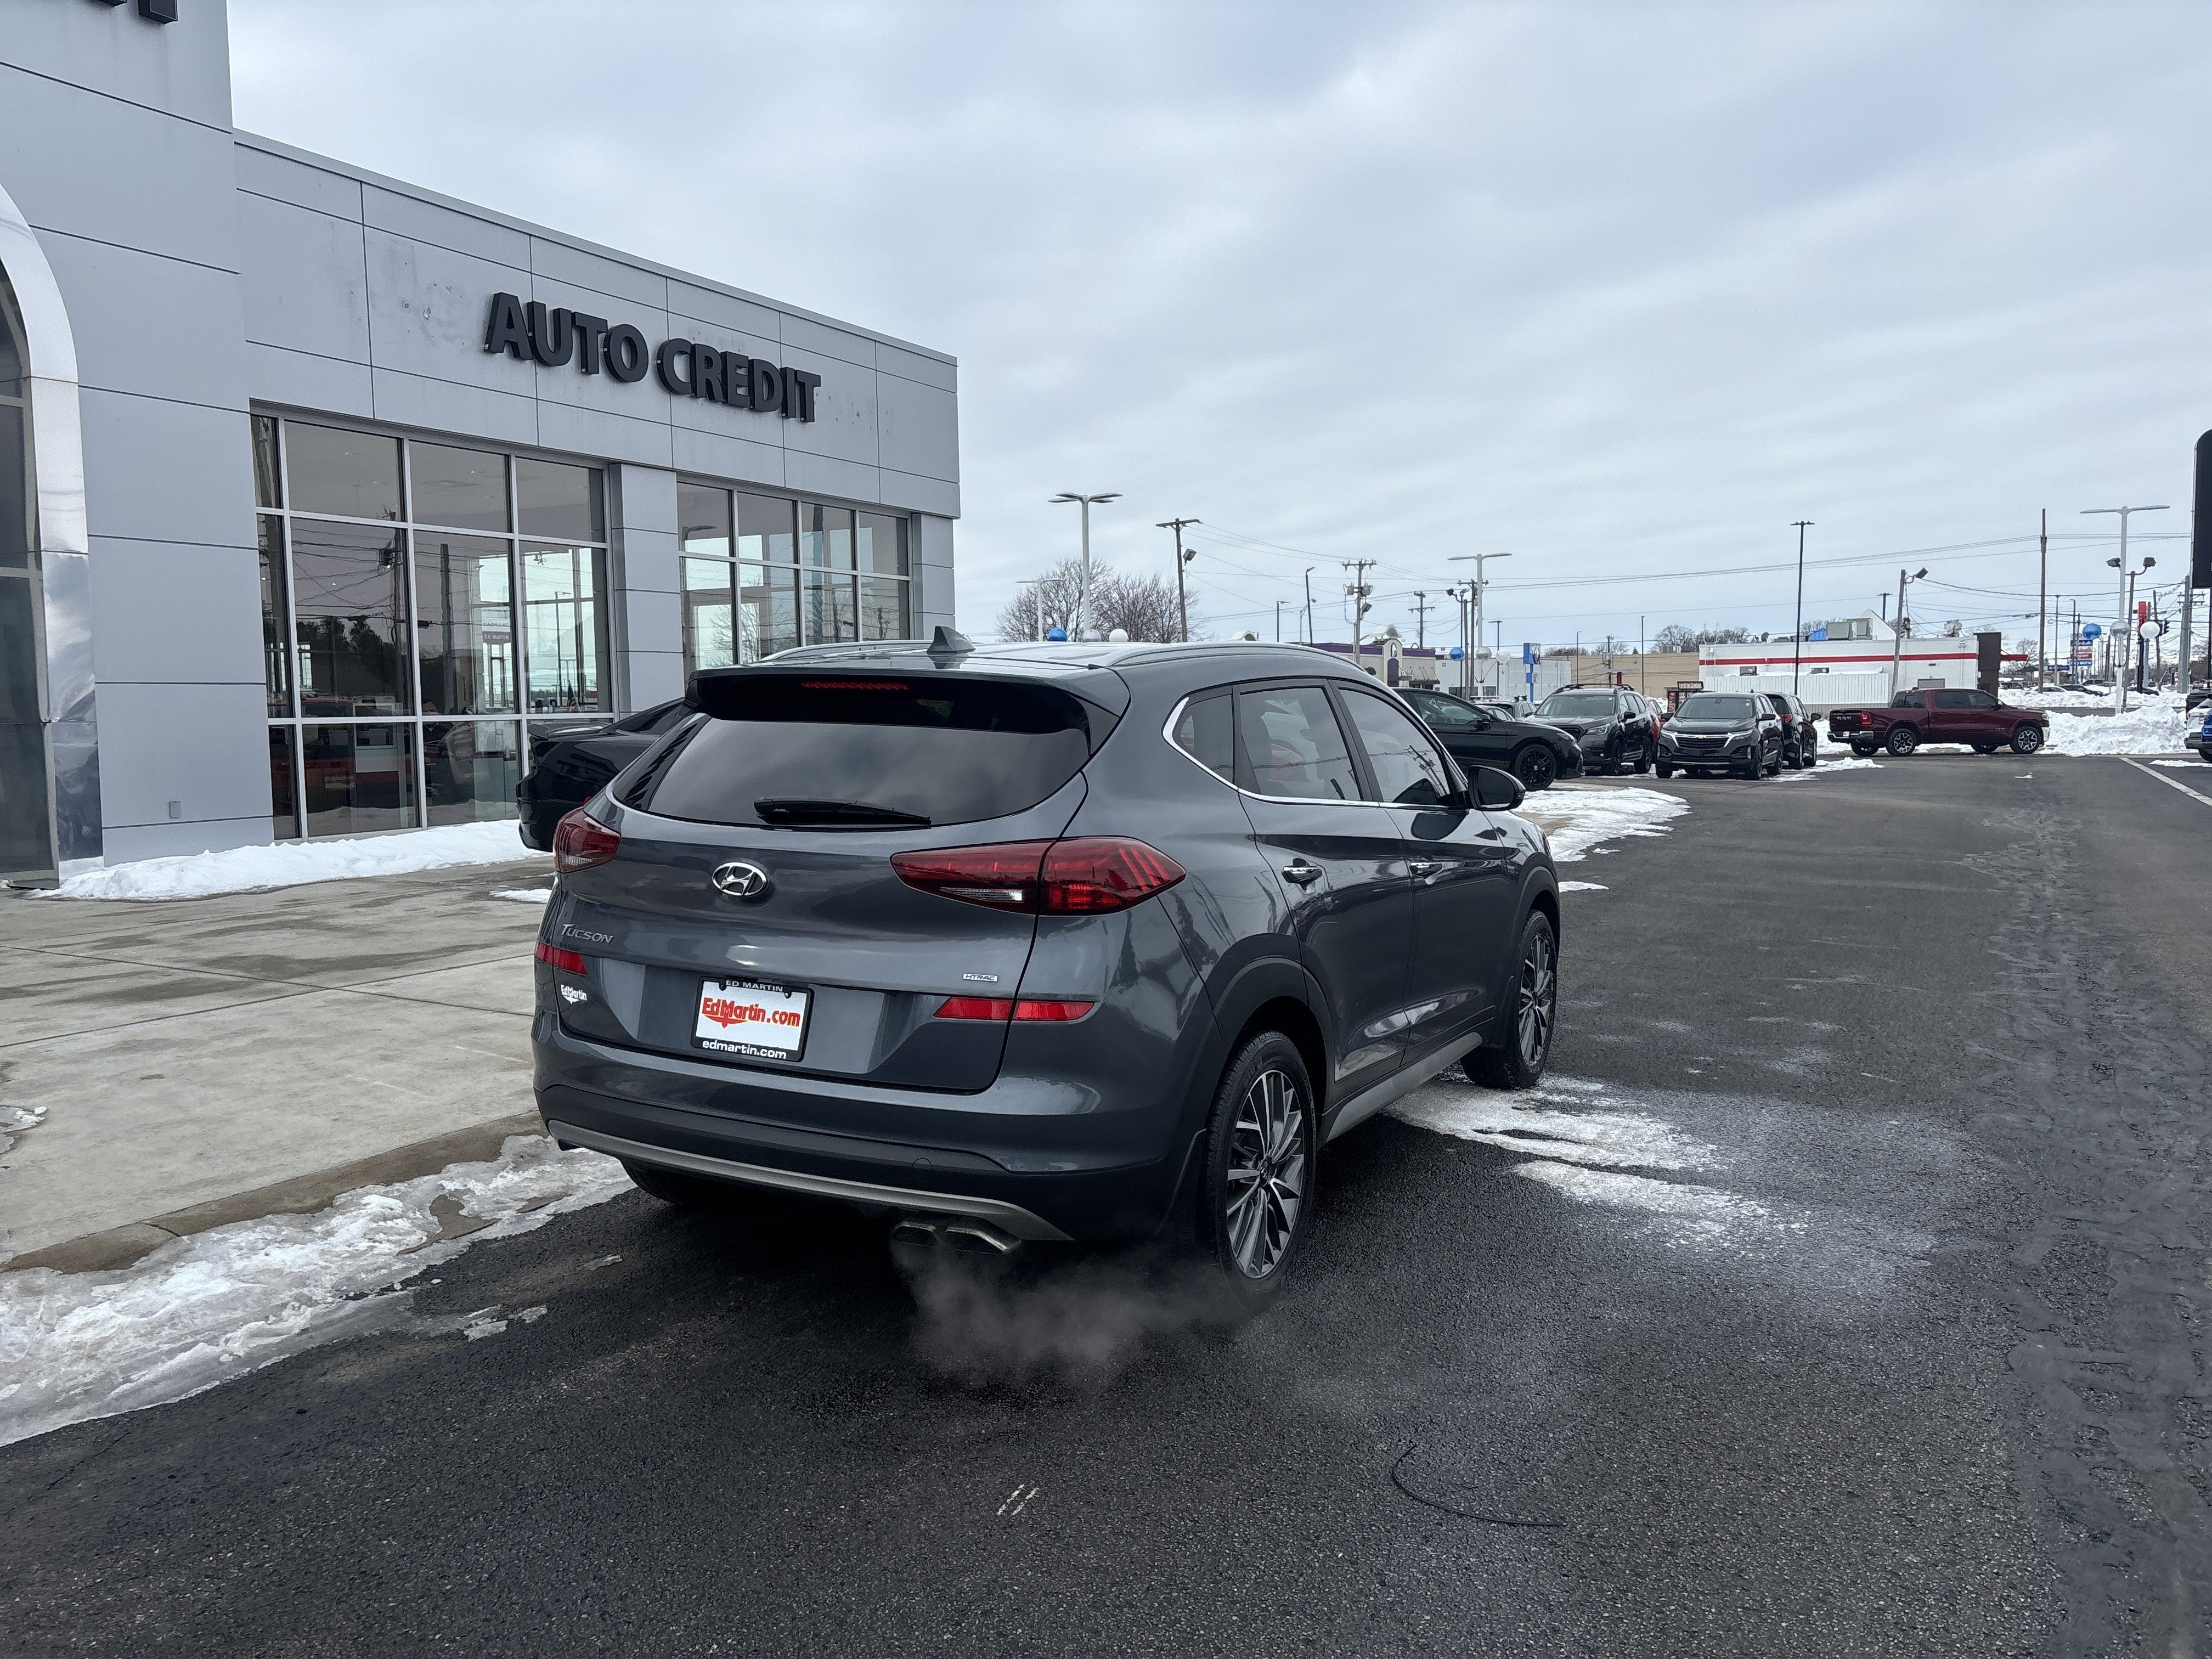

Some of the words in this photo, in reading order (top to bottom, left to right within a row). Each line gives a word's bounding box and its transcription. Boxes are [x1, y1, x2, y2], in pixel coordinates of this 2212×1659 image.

[484, 292, 648, 382] AUTO
[657, 338, 821, 422] CREDIT
[742, 981, 783, 992] MARTIN
[702, 1039, 787, 1059] edmartin.com
